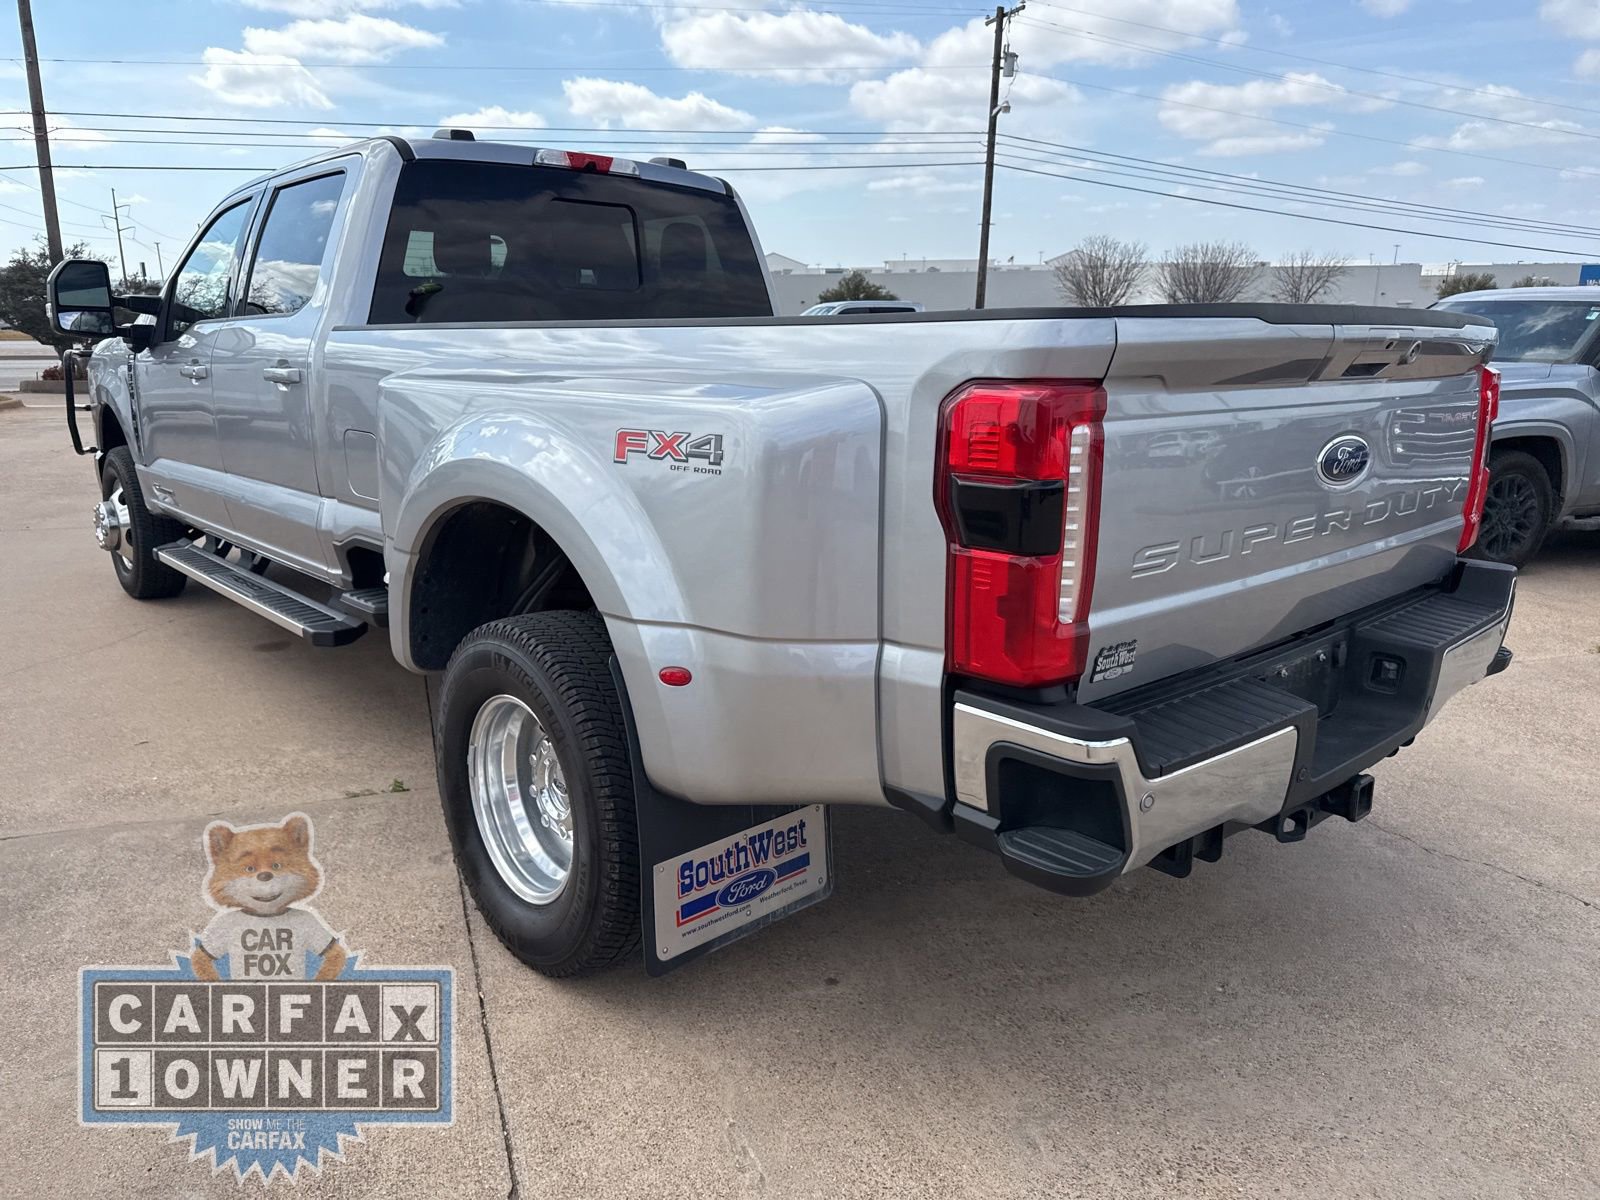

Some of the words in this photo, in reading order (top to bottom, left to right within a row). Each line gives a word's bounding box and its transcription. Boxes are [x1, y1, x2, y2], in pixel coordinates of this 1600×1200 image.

[613, 427, 724, 467] FX4
[1332, 446, 1362, 475] Ford
[670, 464, 690, 472] OFF
[693, 466, 722, 475] ROAD
[1131, 510, 1352, 579] SUPER
[1363, 481, 1463, 526] DUTY
[728, 875, 767, 902] Ford
[682, 905, 750, 937] www.southwestford.com
